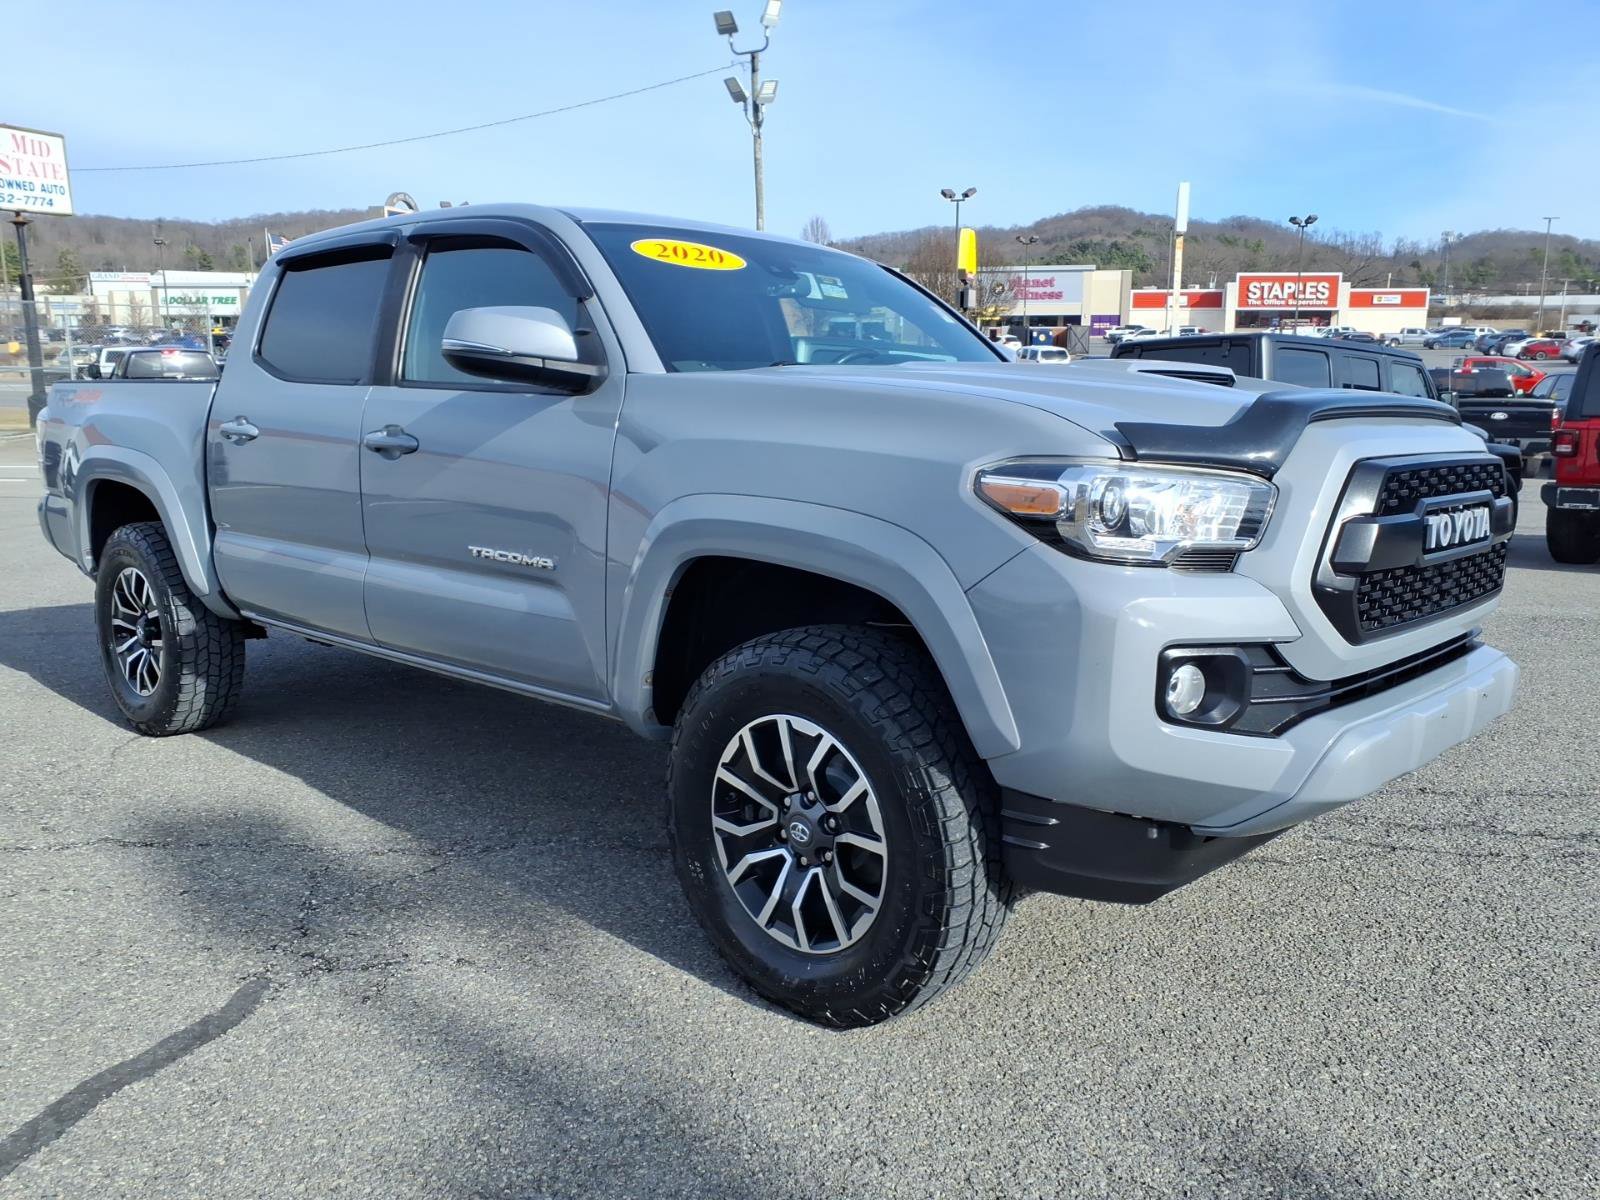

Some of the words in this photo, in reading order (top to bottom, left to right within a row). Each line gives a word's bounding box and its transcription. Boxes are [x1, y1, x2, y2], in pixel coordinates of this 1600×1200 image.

[11, 133, 51, 157] MID
[0, 153, 65, 180] STATE
[41, 183, 65, 195] AUTO
[655, 243, 724, 264] 2020
[169, 296, 209, 305] DOLLAR
[211, 297, 238, 305] TREE
[1247, 281, 1330, 299] STAPLES
[1424, 506, 1491, 549] TOYOTA
[468, 545, 554, 570] TACOMA
